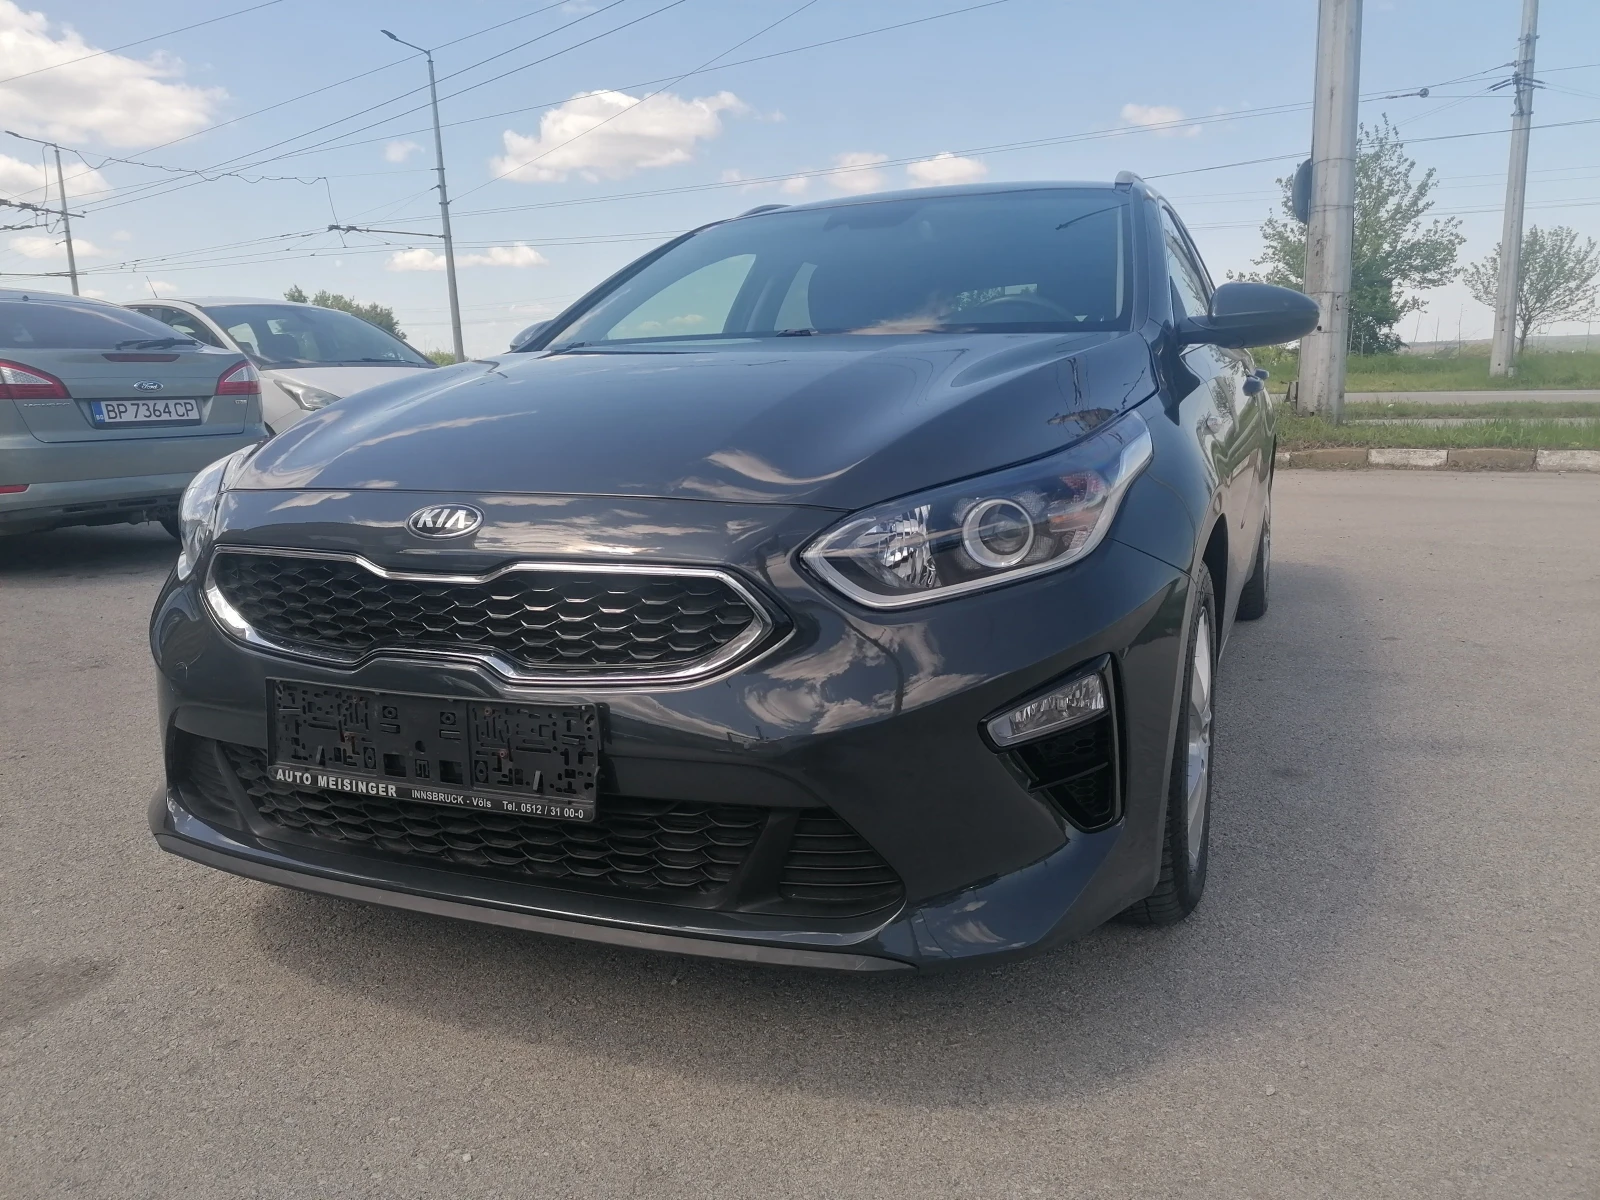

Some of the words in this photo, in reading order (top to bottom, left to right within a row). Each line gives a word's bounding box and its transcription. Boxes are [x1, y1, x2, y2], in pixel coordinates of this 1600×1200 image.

[141, 380, 158, 390] Ford
[417, 508, 467, 529] KIA
[276, 768, 312, 785] AUTO
[317, 774, 397, 797] MEISINGER
[411, 789, 464, 805] INNSBRUCK
[472, 797, 492, 808] Völs
[502, 801, 518, 812] Tel.
[521, 803, 542, 814] 0512
[550, 806, 561, 816] 31
[564, 808, 584, 819] 00-0
